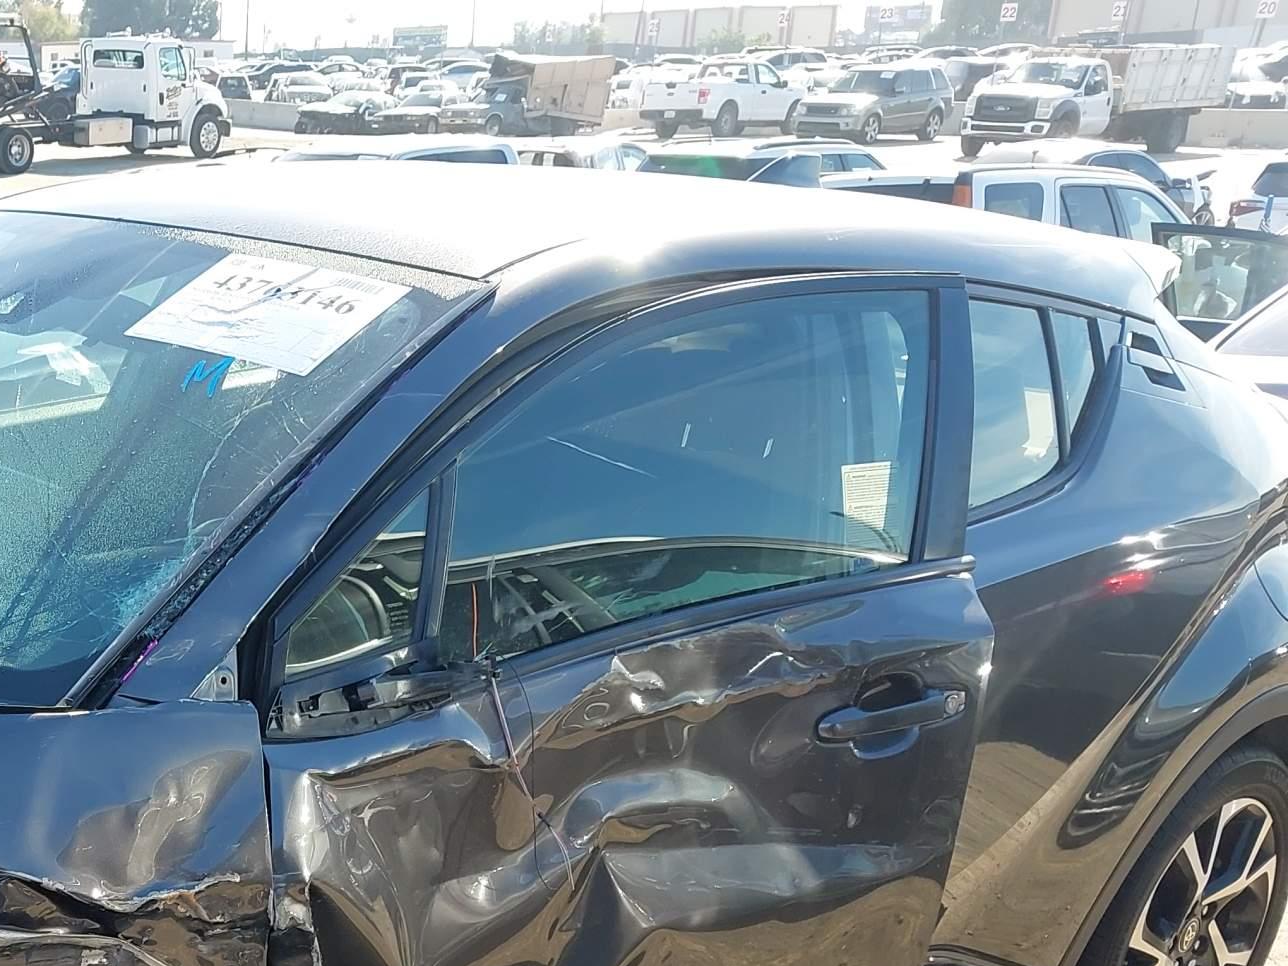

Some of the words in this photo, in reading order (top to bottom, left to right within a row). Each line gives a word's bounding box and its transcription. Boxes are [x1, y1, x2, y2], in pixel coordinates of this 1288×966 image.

[880, 8, 894, 19] 23
[1002, 7, 1017, 18] 22
[1258, 2, 1276, 14] 20
